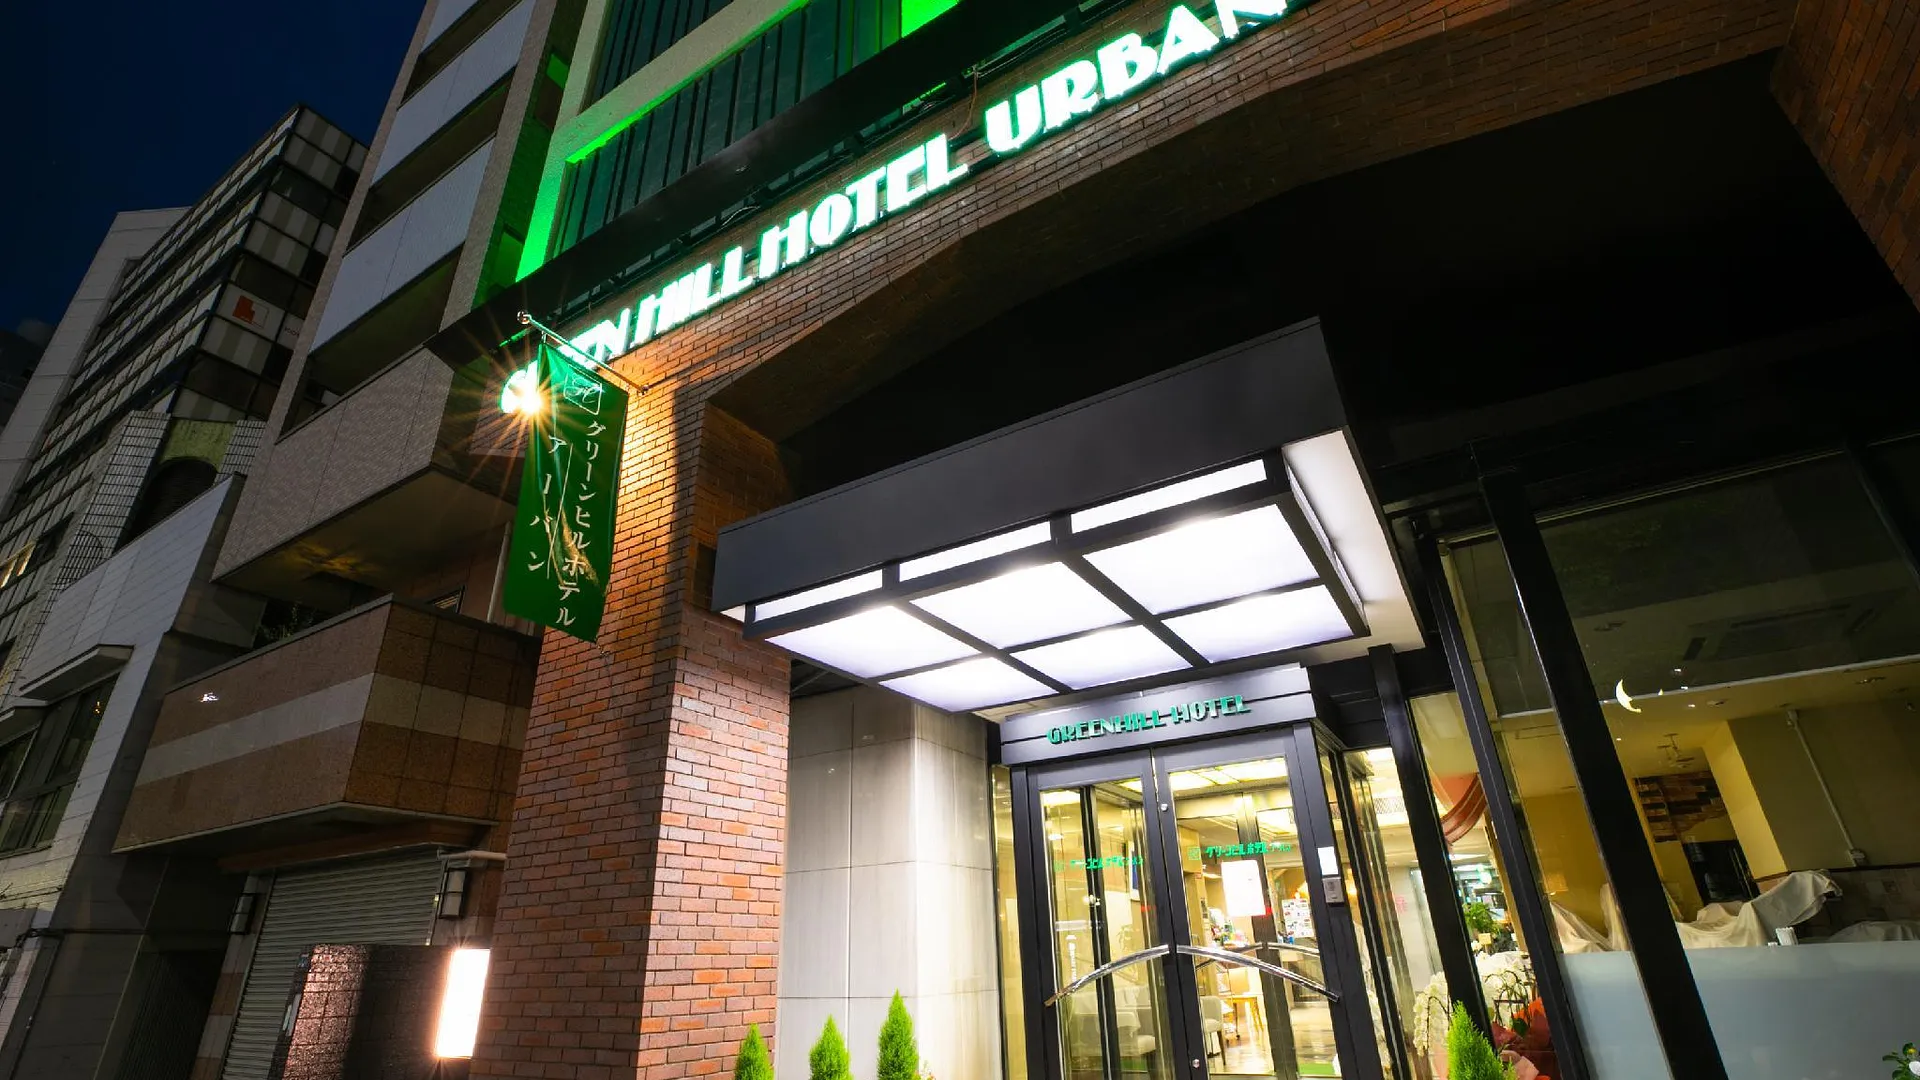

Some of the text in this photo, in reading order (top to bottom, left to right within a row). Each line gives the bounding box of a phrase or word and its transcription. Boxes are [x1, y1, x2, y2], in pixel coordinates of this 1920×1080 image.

[758, 132, 969, 278] HOTEL
[527, 435, 568, 572] アーバン
[556, 420, 606, 626] グリーンヒルホテル
[1170, 694, 1252, 724] HOTEL
